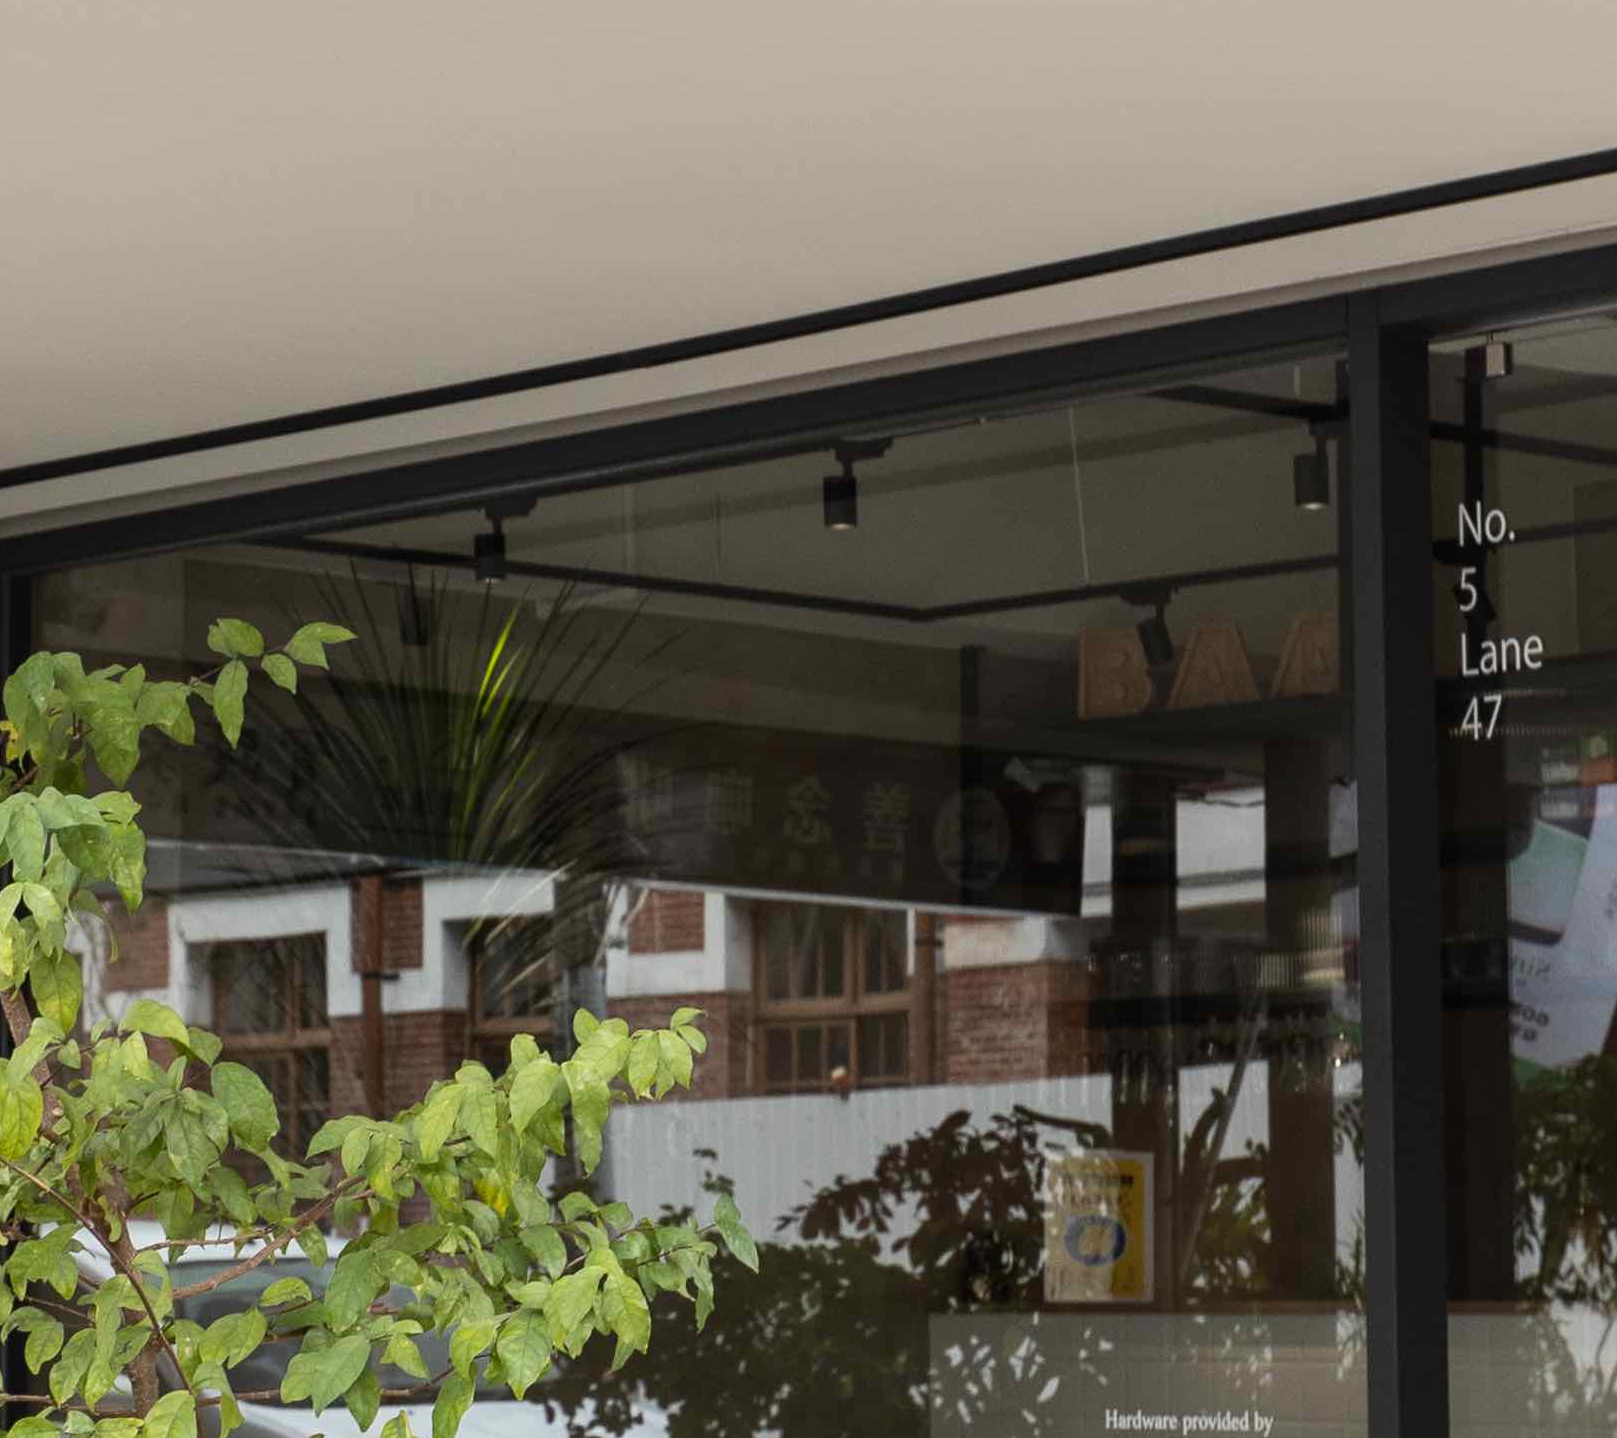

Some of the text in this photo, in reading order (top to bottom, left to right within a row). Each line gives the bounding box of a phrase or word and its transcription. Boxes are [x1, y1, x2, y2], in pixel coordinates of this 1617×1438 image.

[1457, 500, 1517, 547] No.
[1458, 566, 1479, 613] 5
[1460, 629, 1545, 677] Lane
[1460, 693, 1503, 741] 47
[1105, 1409, 1275, 1438] Hardware provided by
